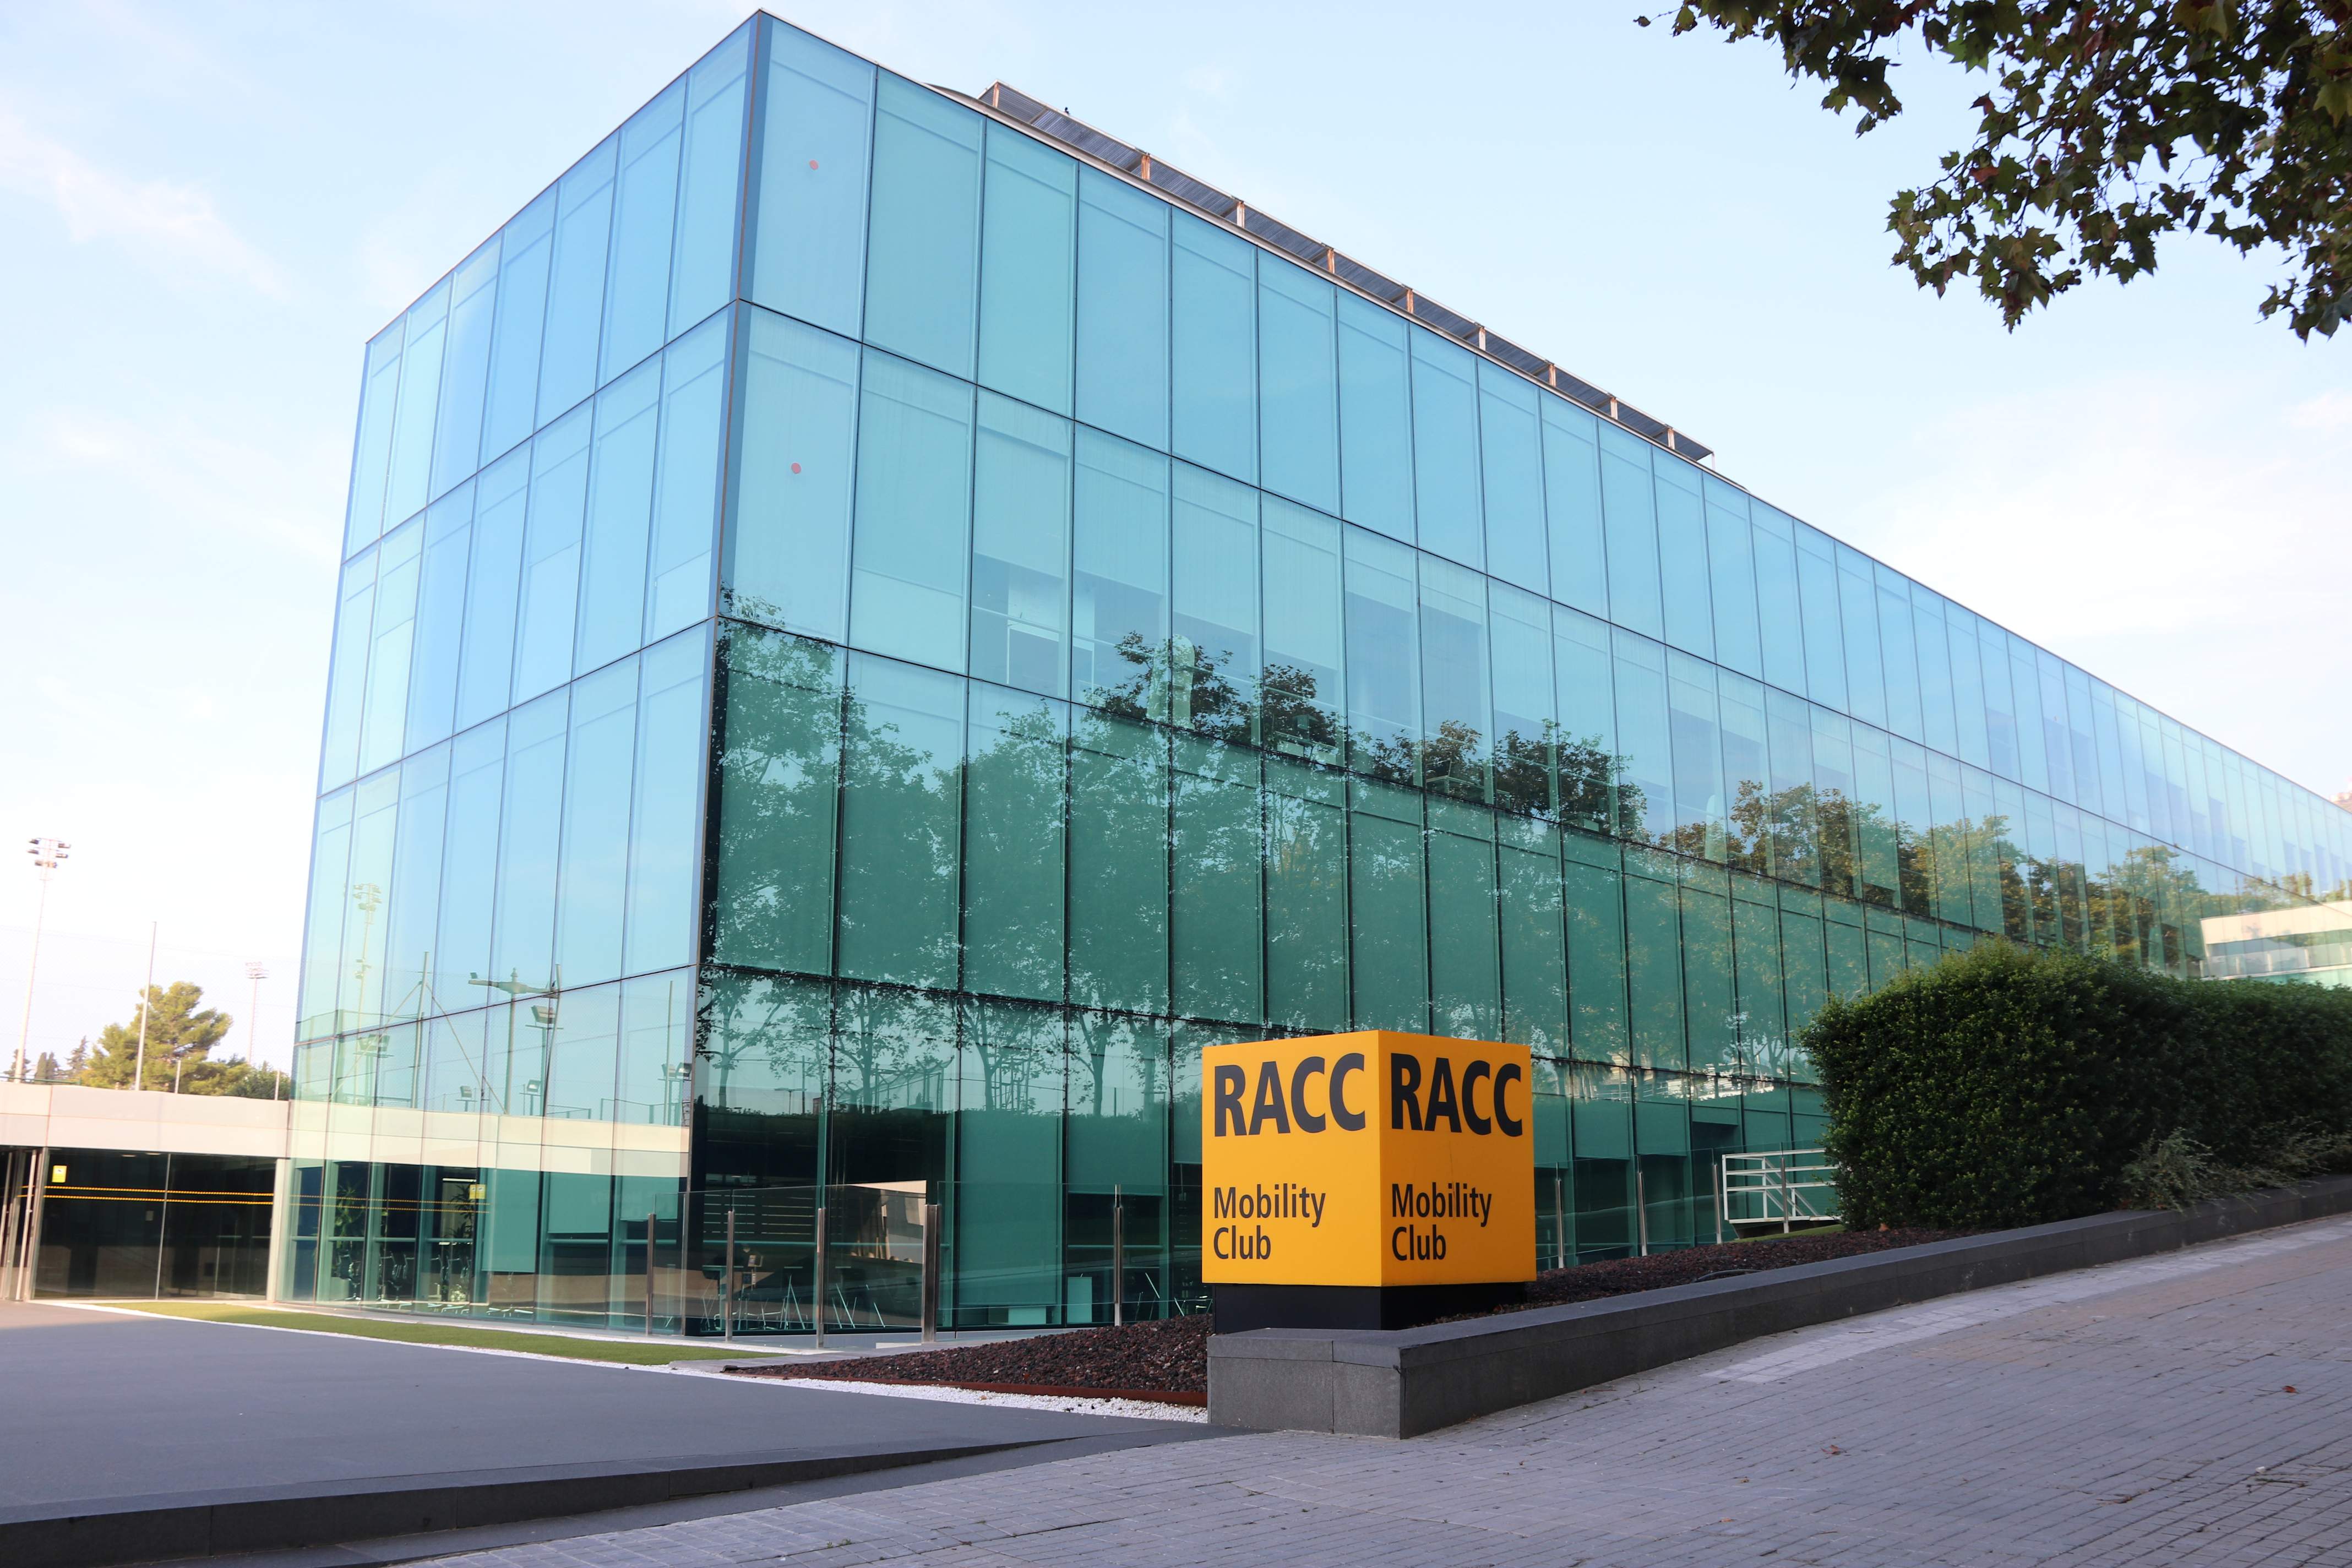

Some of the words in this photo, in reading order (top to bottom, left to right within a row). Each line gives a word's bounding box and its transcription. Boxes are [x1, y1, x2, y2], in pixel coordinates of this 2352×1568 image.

[1214, 1053, 1366, 1137] RACC
[1390, 1053, 1523, 1137] RACC
[1214, 1183, 1326, 1228] Mobility
[1392, 1182, 1492, 1228] Mobility
[1213, 1225, 1271, 1260] Club
[1392, 1224, 1446, 1261] Club
